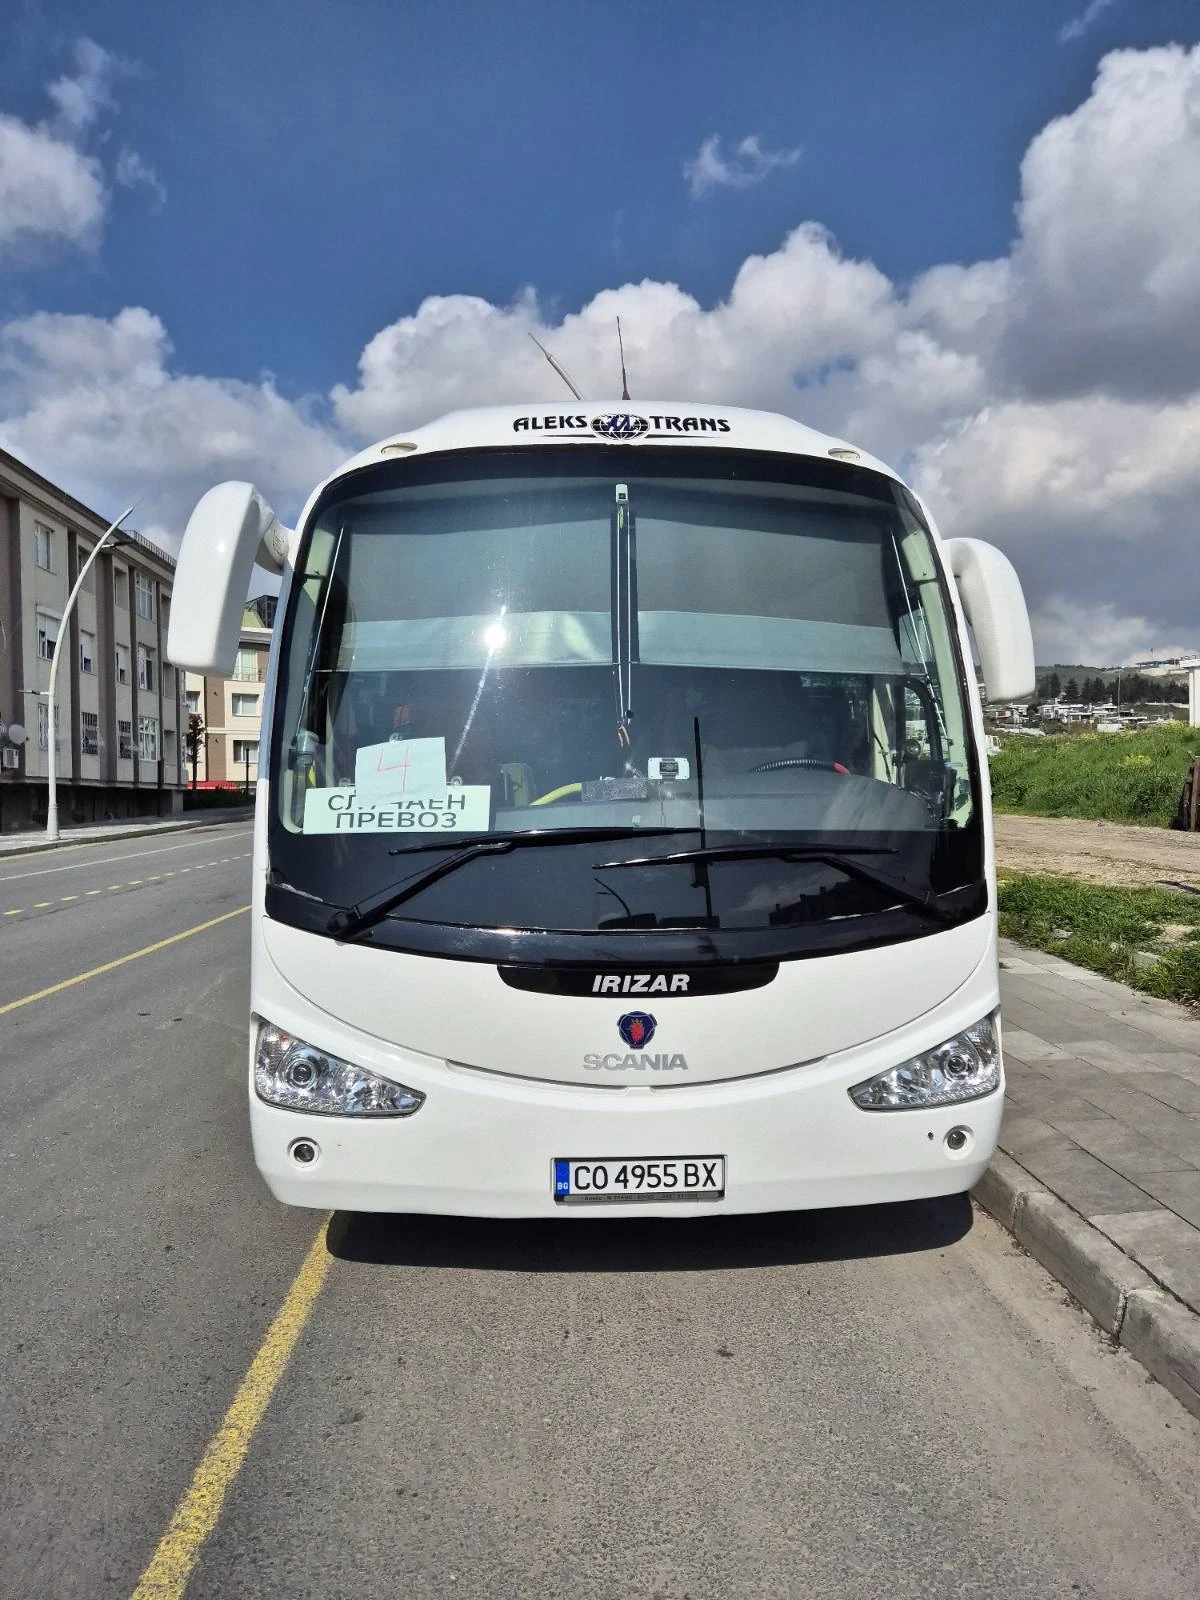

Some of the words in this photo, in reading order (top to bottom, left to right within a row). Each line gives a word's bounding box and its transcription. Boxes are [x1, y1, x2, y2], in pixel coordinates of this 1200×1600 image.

[513, 415, 588, 432] ALEKS
[649, 415, 731, 432] TRANS
[376, 745, 411, 793] 4
[335, 811, 458, 829] ПРЕВОЗ
[592, 973, 691, 993] IRIZAR
[583, 1053, 689, 1071] SCANIA
[614, 1164, 678, 1190] 4955
[684, 1162, 717, 1188] BX
[556, 1182, 569, 1190] BG
